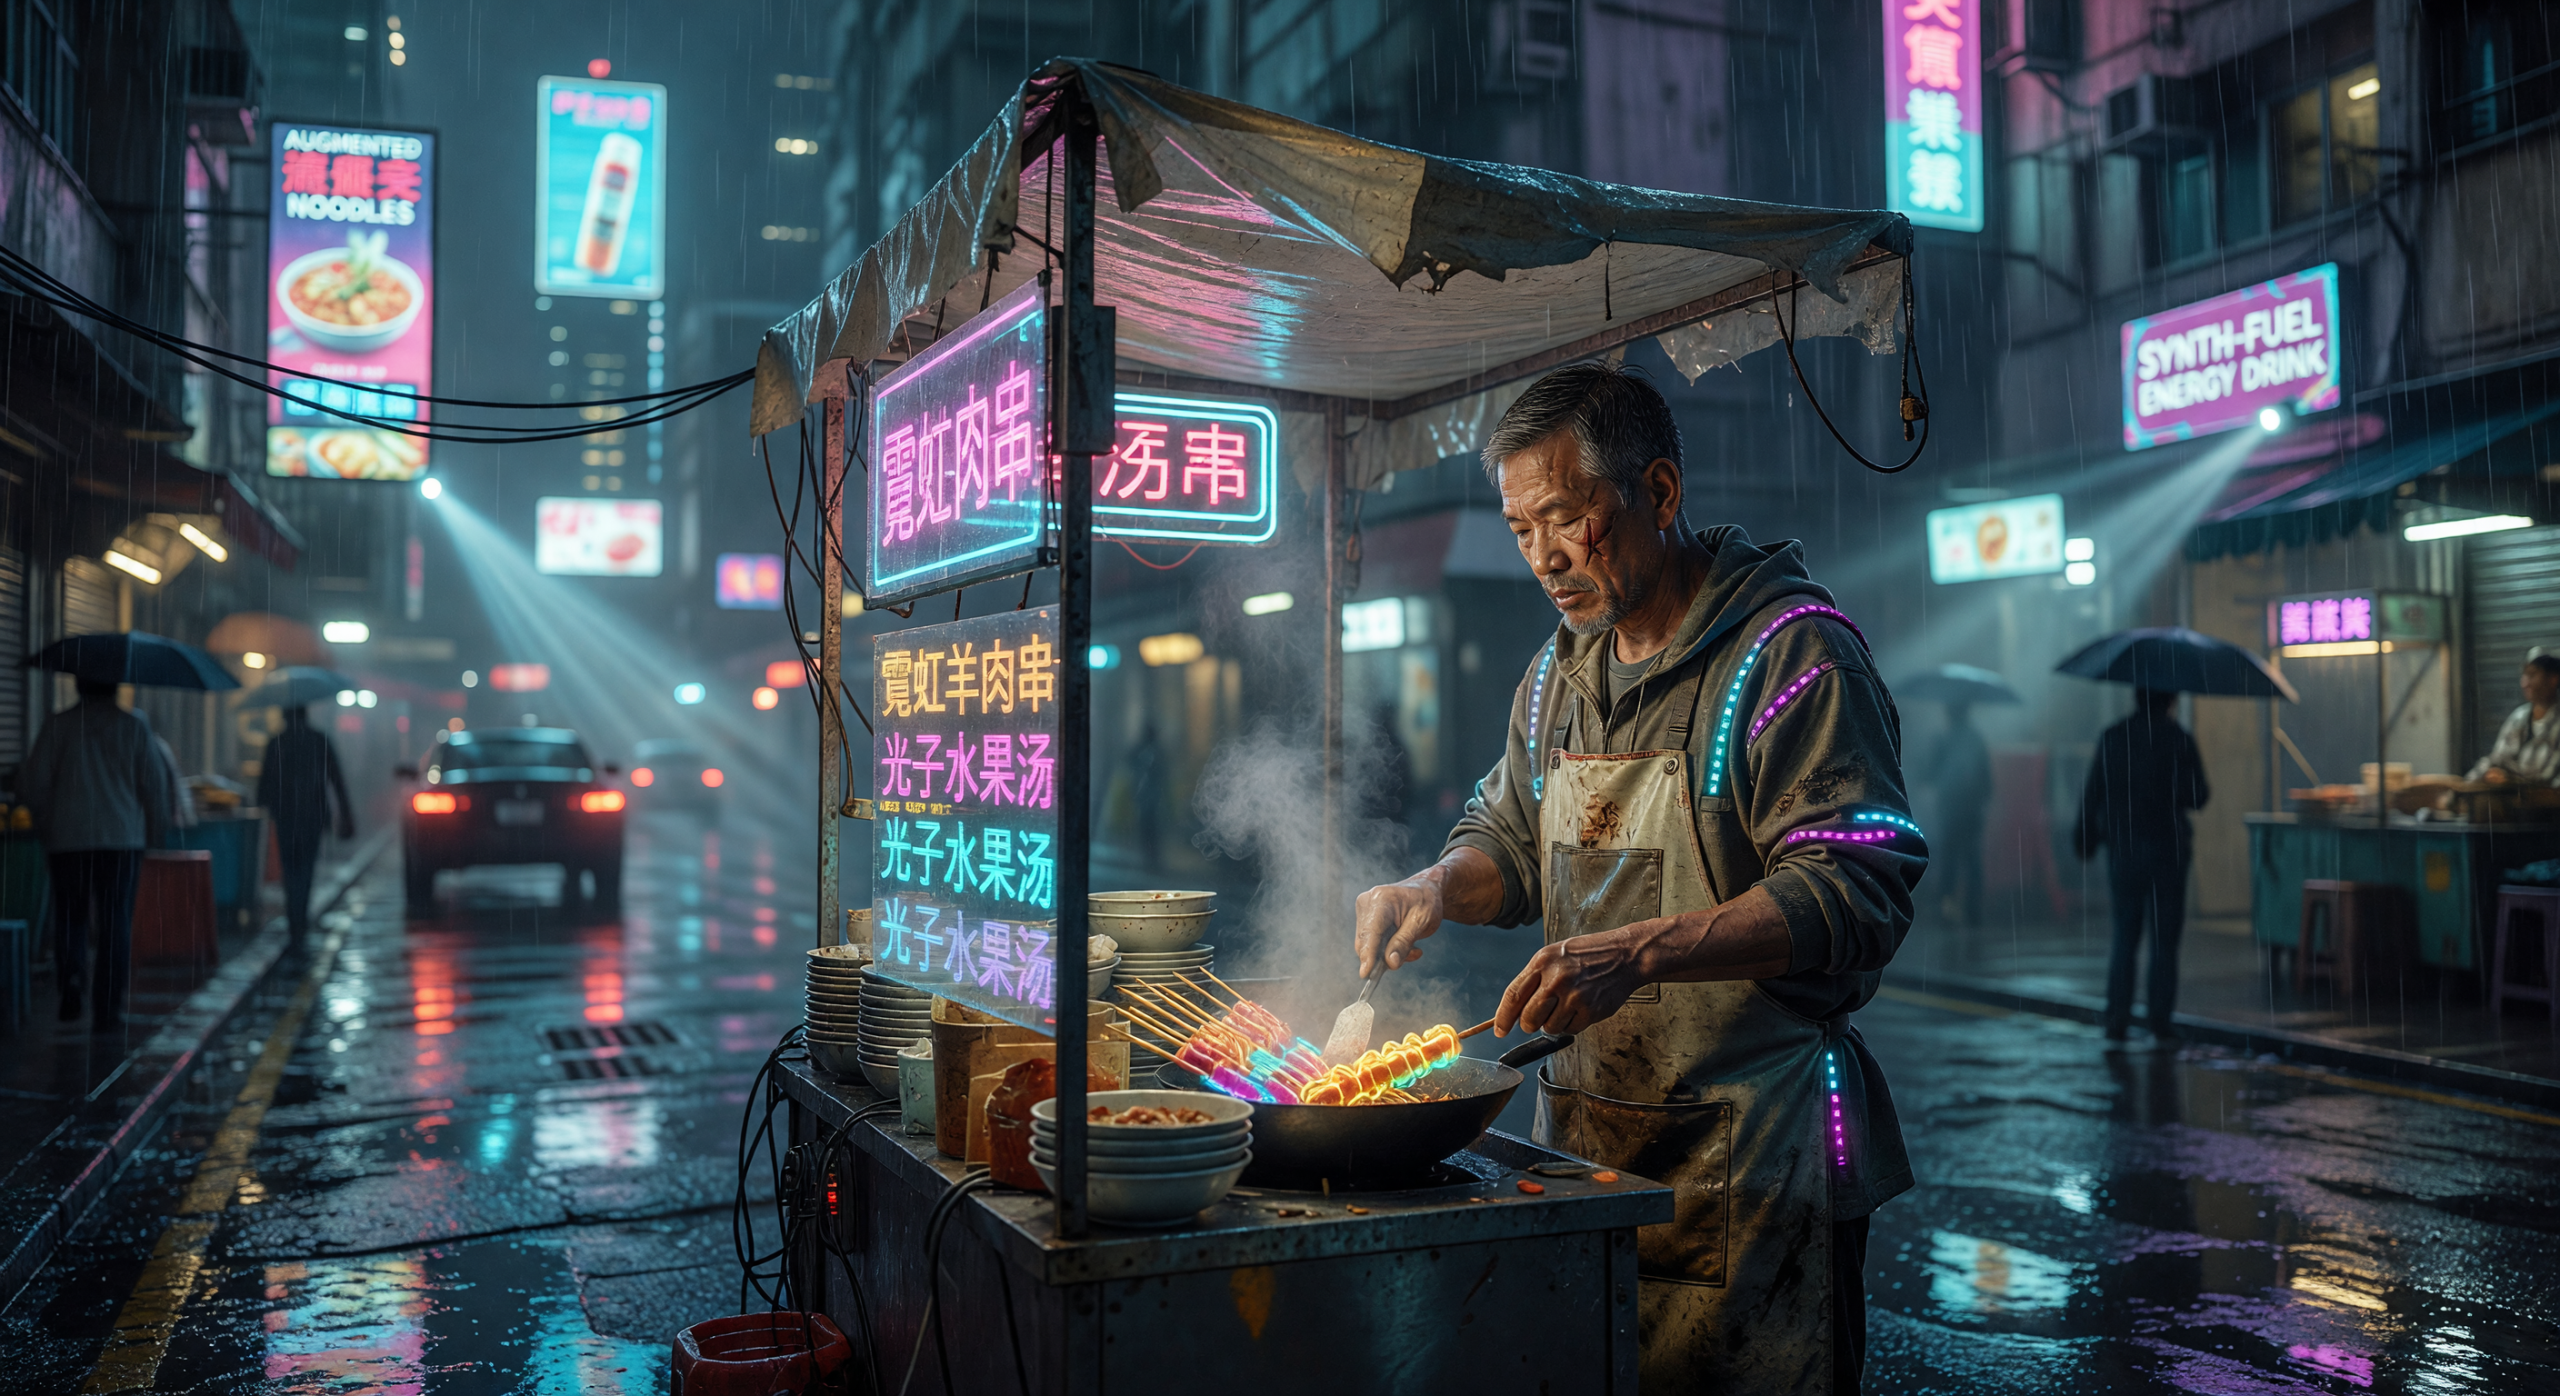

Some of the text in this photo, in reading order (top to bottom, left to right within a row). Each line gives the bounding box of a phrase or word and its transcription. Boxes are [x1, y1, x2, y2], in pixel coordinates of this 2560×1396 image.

[283, 129, 422, 160] AUGMENTED
[286, 192, 415, 226] NOODLES
[2137, 297, 2324, 380] SYNTH-FUEL
[2138, 338, 2327, 417] ENERGY DRINK
[881, 633, 1055, 717] 霓虹羊肉串
[881, 731, 1055, 809] 光子水果汤
[881, 816, 1054, 909] 光子水果汤
[880, 897, 1054, 1010] 光子水果汤
